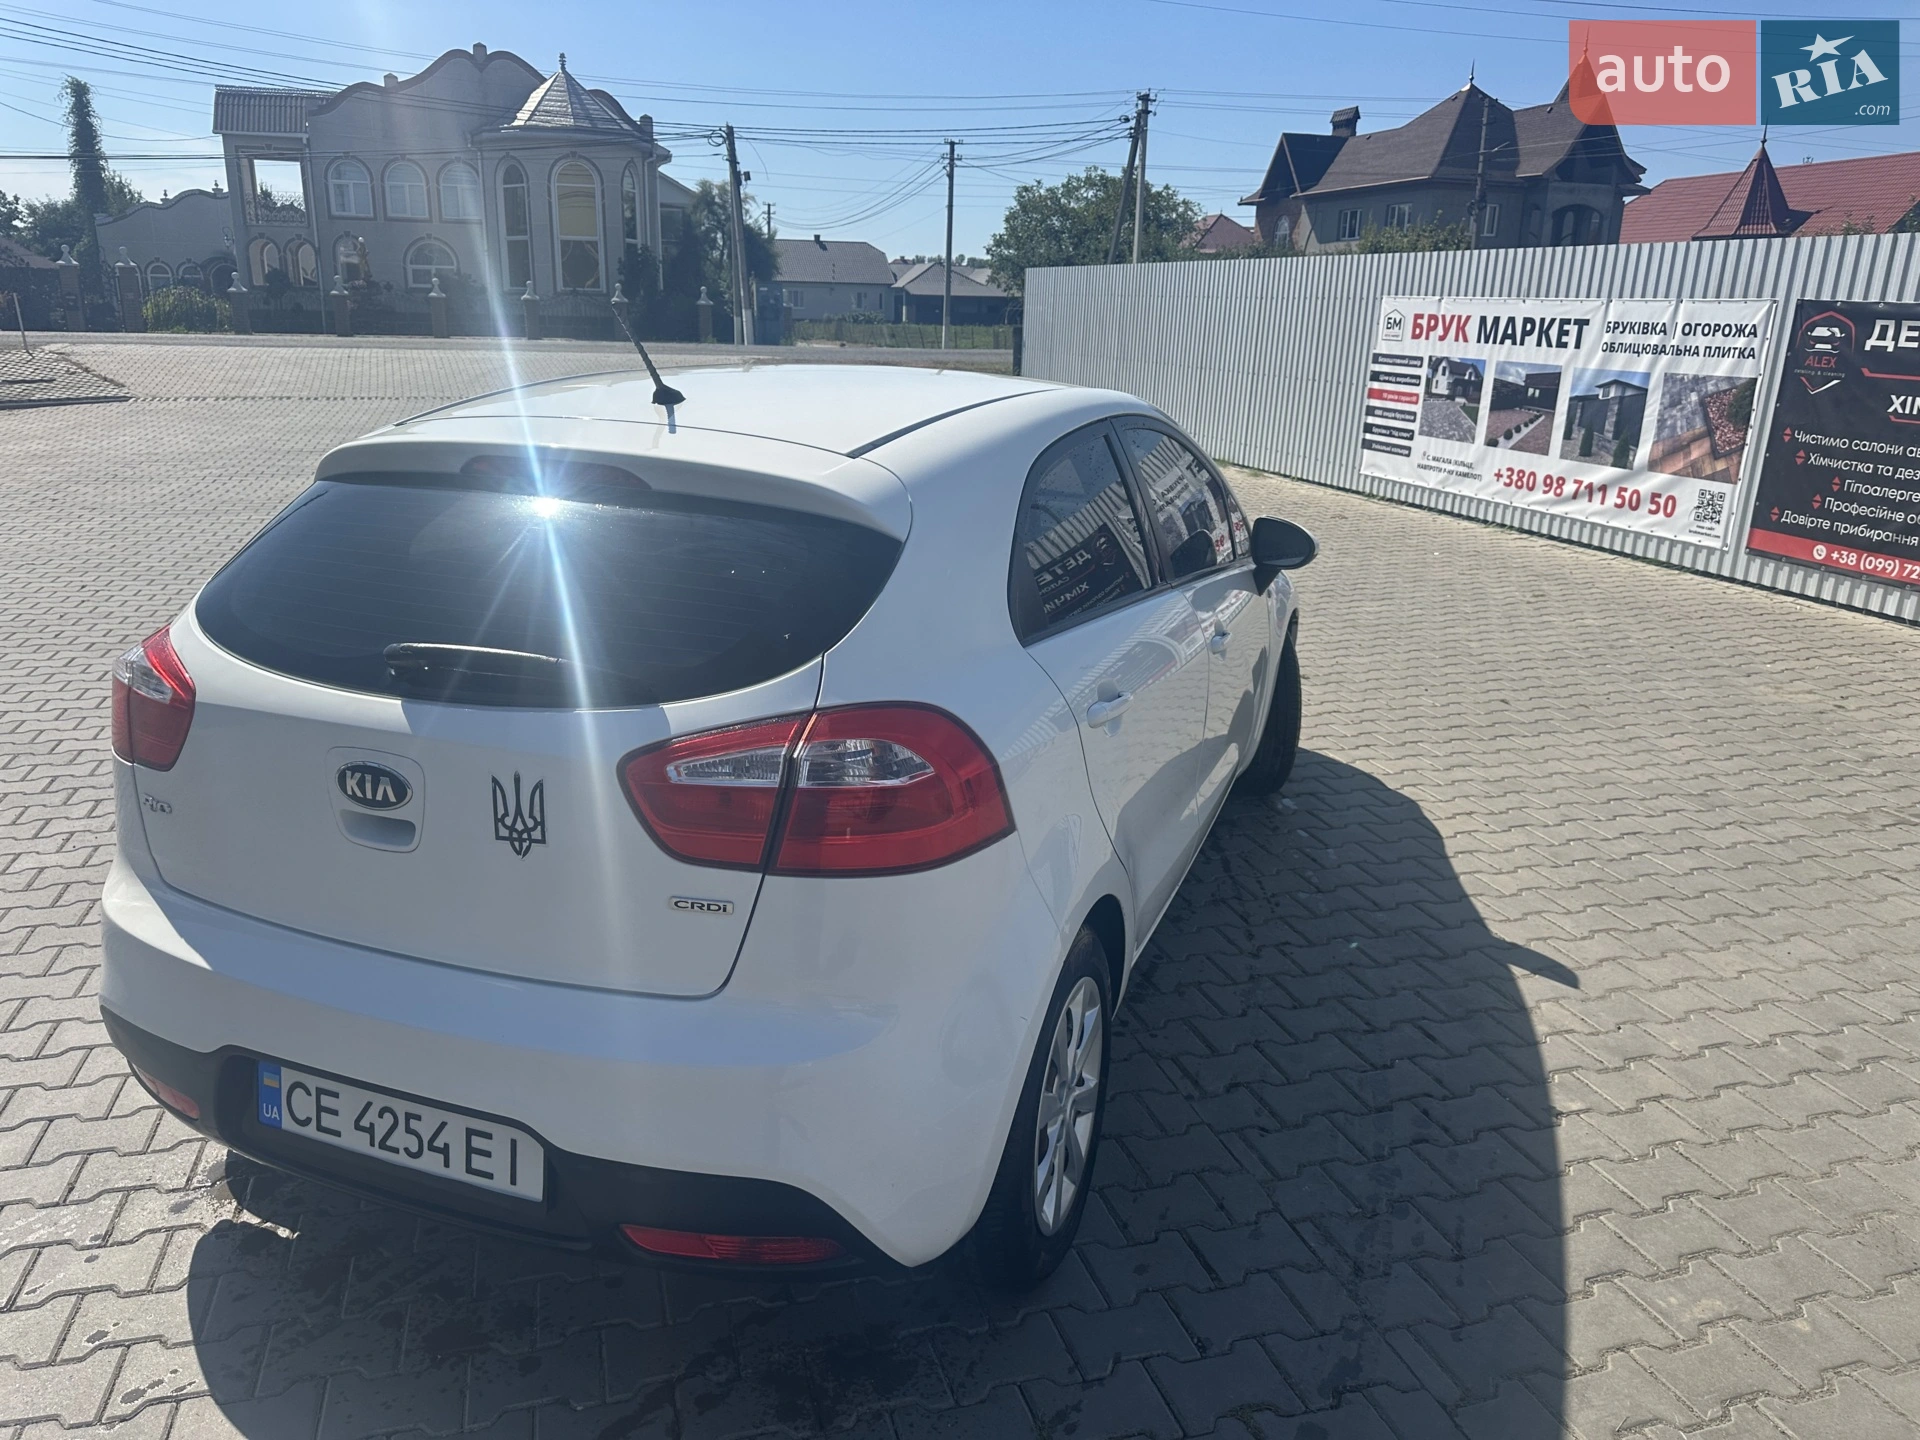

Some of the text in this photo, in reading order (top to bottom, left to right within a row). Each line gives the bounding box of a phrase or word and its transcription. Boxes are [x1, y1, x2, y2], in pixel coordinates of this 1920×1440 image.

[1386, 317, 1402, 330] БМ
[1411, 313, 1590, 350] БРУК МАРКЕТ
[1605, 321, 1667, 336] БРУКІВКА
[1681, 322, 1758, 338] ОГОРОЖА
[1864, 319, 1920, 352] ДЕ
[1601, 341, 1756, 360] ОБЛИЦЮВАЛЬНА ПЛИТКА
[1804, 355, 1837, 368] ALEX
[1794, 430, 1849, 449] Чистимо
[1852, 440, 1903, 456] салони
[1807, 453, 1873, 474] Хімчистка
[1877, 465, 1893, 476] та
[1494, 467, 1677, 518] +380 98 711 50 50
[1843, 480, 1920, 503] Гіпоалерге
[1824, 497, 1904, 522] Професійне
[1780, 510, 1919, 547] Довірте прибирання
[1831, 550, 1857, 566] +38
[1860, 553, 1899, 577] (099)
[345, 769, 397, 803] KIA
[674, 900, 727, 913] CRDi
[263, 1103, 280, 1120] UA
[286, 1081, 517, 1186] CE 4254 EI
